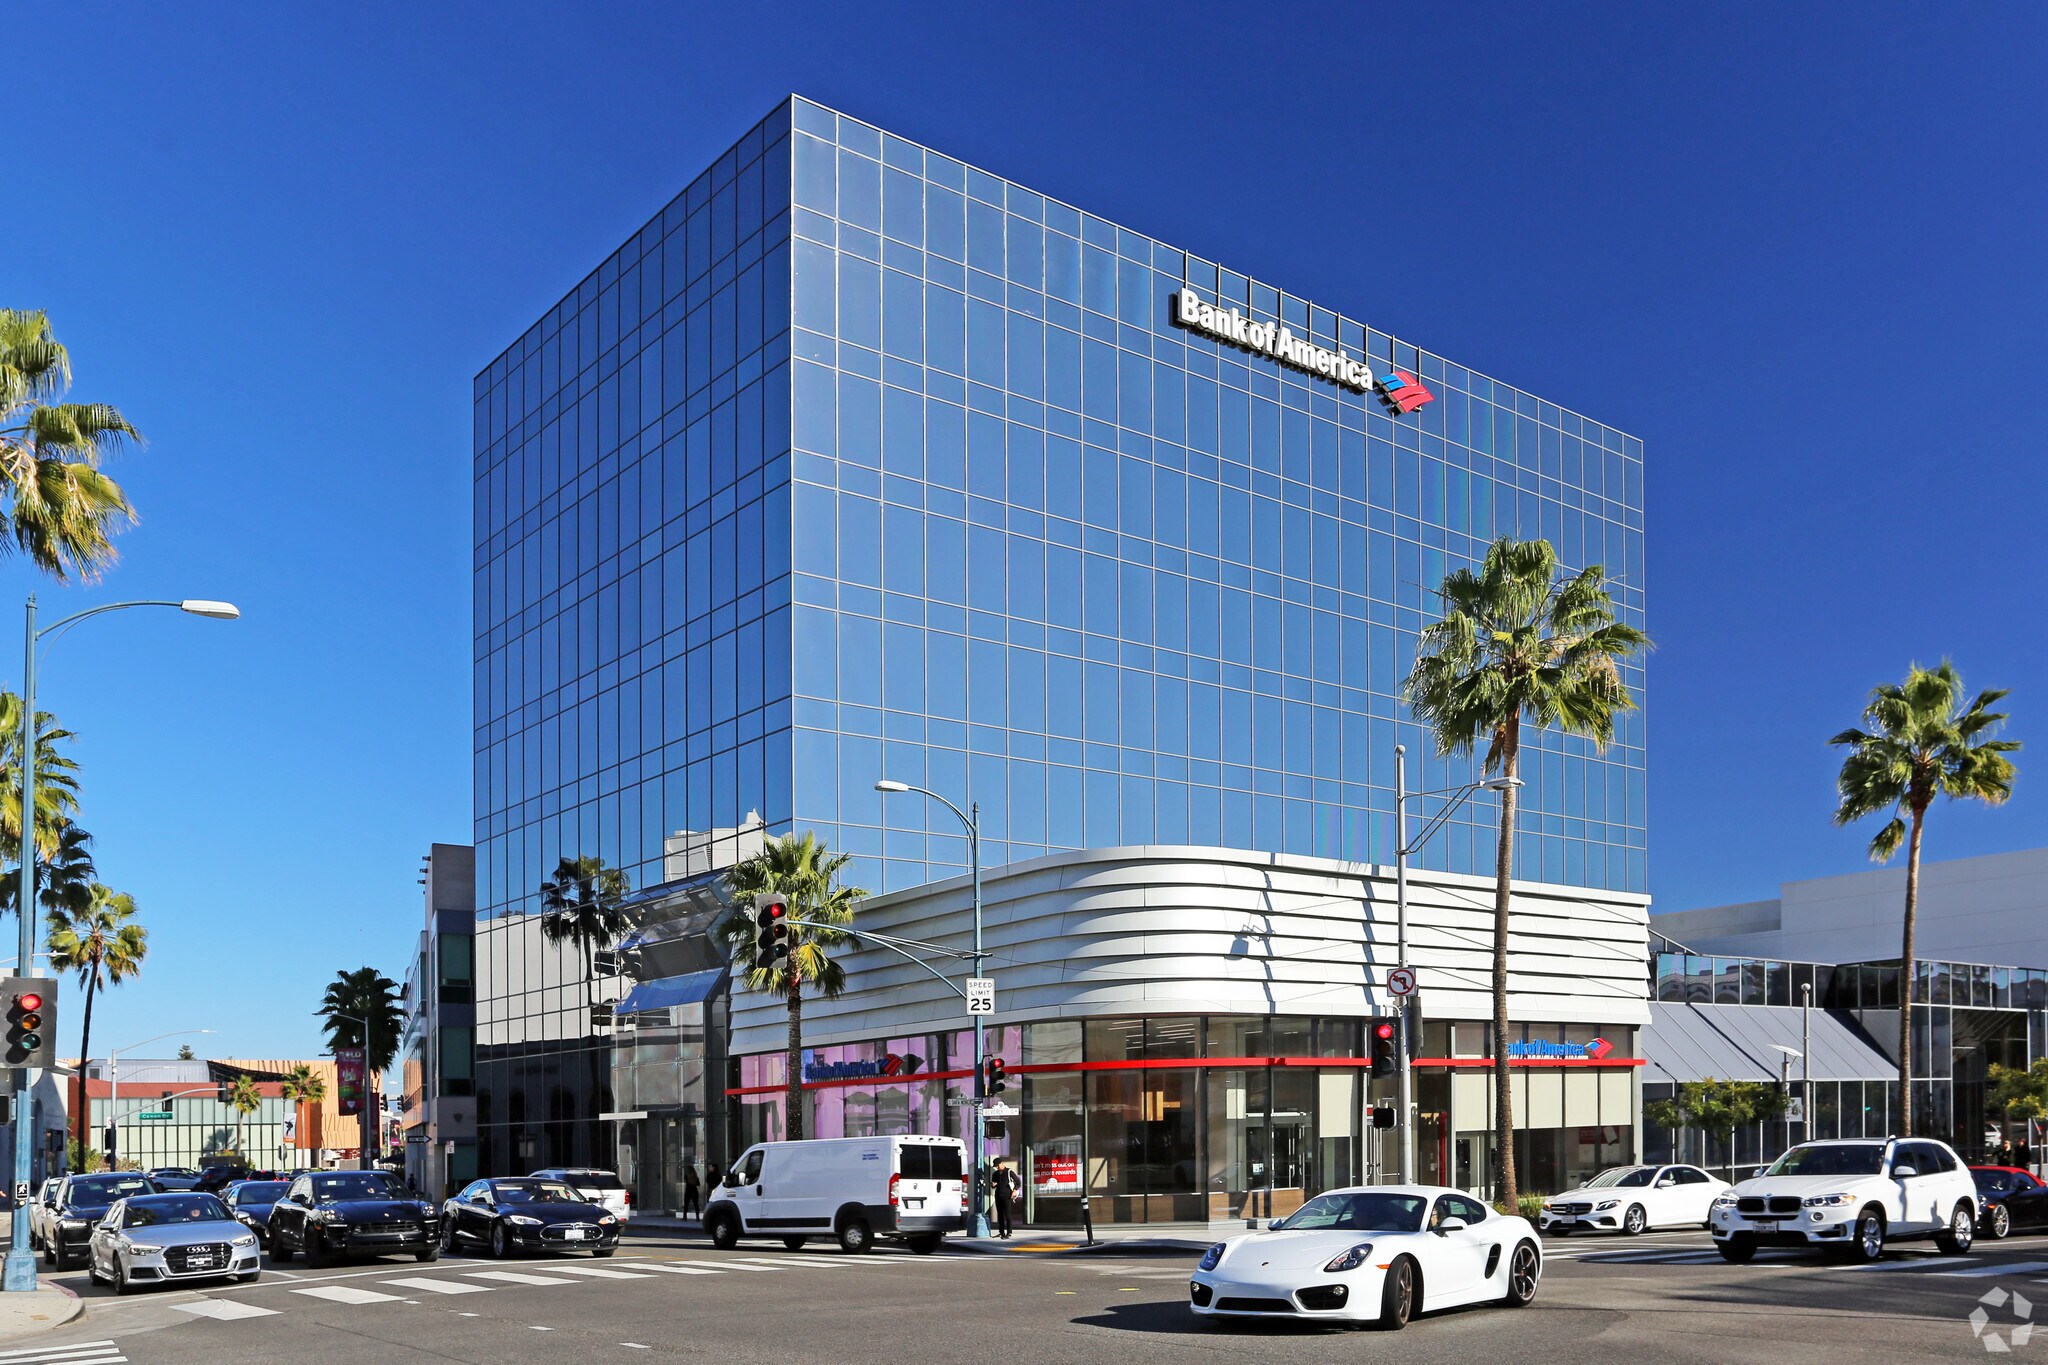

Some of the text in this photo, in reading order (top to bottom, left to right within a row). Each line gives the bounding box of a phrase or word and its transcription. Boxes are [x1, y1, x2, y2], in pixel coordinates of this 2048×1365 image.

[1178, 287, 1374, 390] Bank of America
[971, 998, 991, 1011] 25
[1507, 1039, 1585, 1055] ank of America
[805, 1062, 827, 1079] Bank
[838, 1059, 876, 1077] America
